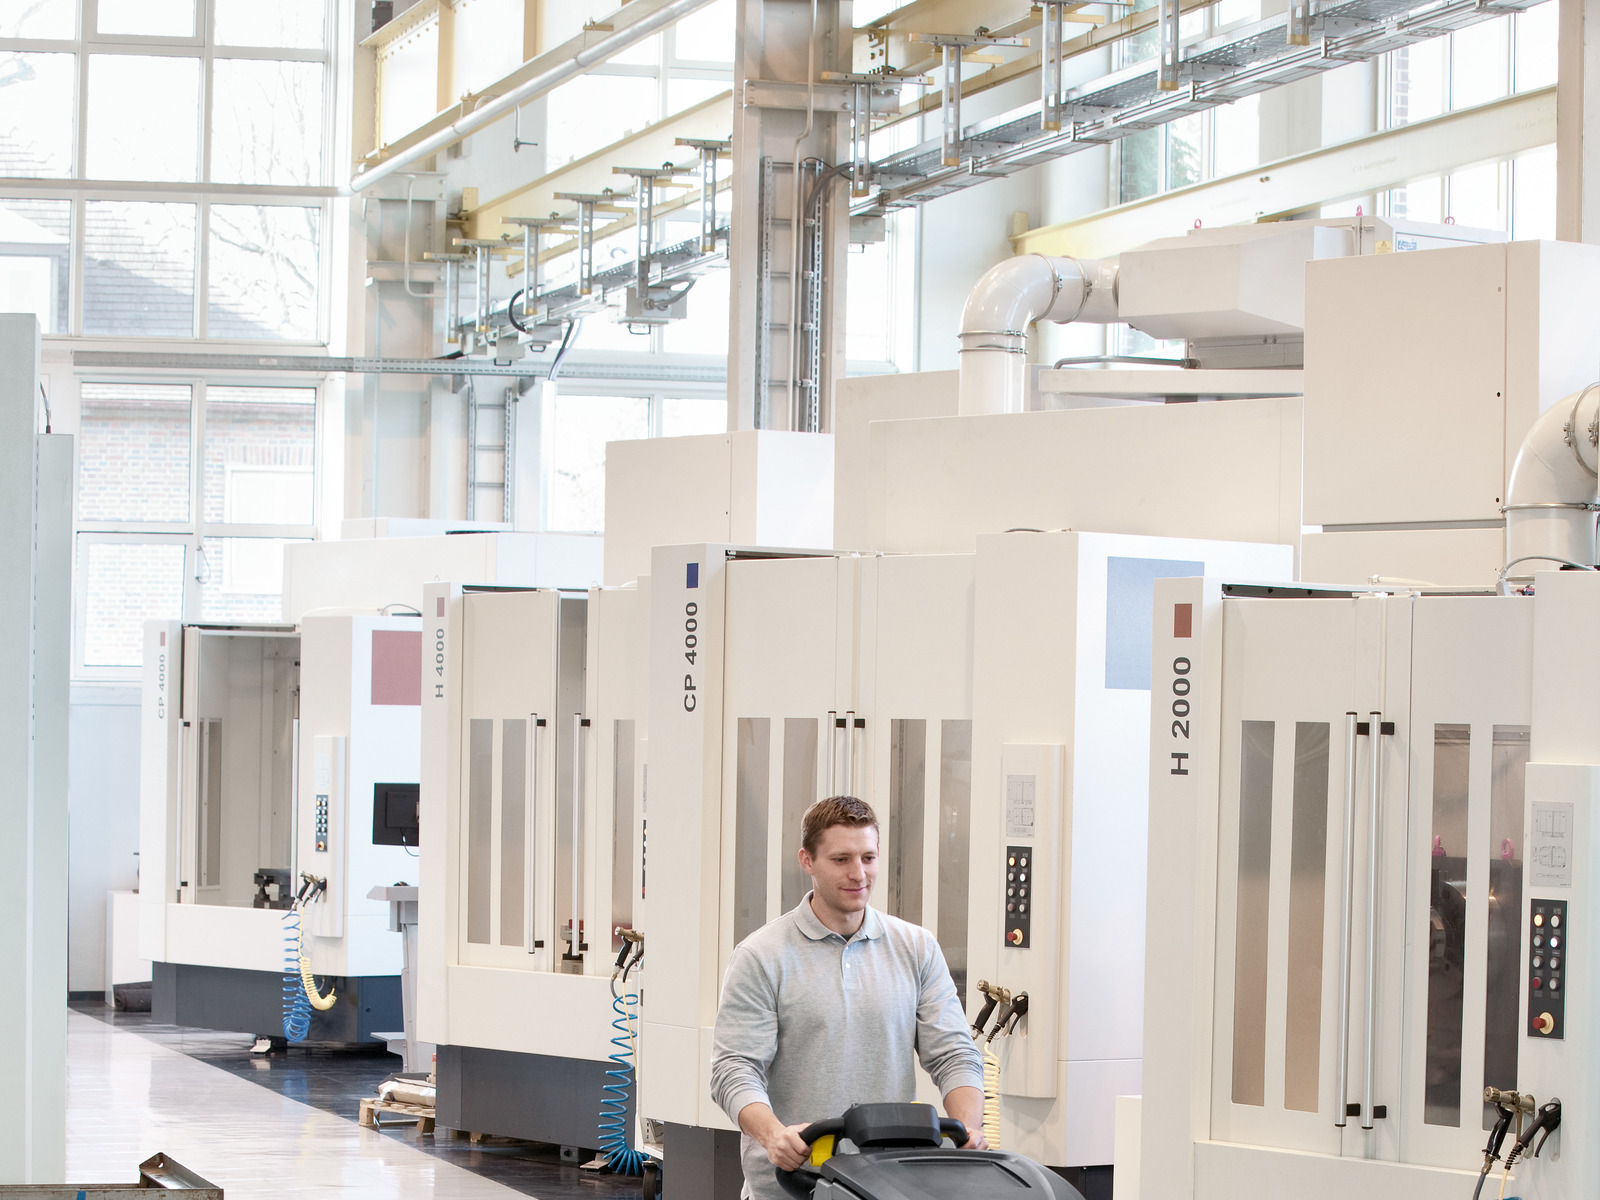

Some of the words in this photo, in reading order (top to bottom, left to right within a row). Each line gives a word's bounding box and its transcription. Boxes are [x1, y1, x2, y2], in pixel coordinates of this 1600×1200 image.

[435, 628, 445, 677] 4000
[684, 601, 699, 666] 4000
[158, 653, 166, 692] 4000
[434, 684, 445, 698] H
[157, 696, 165, 719] CP
[683, 673, 697, 713] CP
[1171, 656, 1192, 740] 2000
[1170, 752, 1189, 776] H
